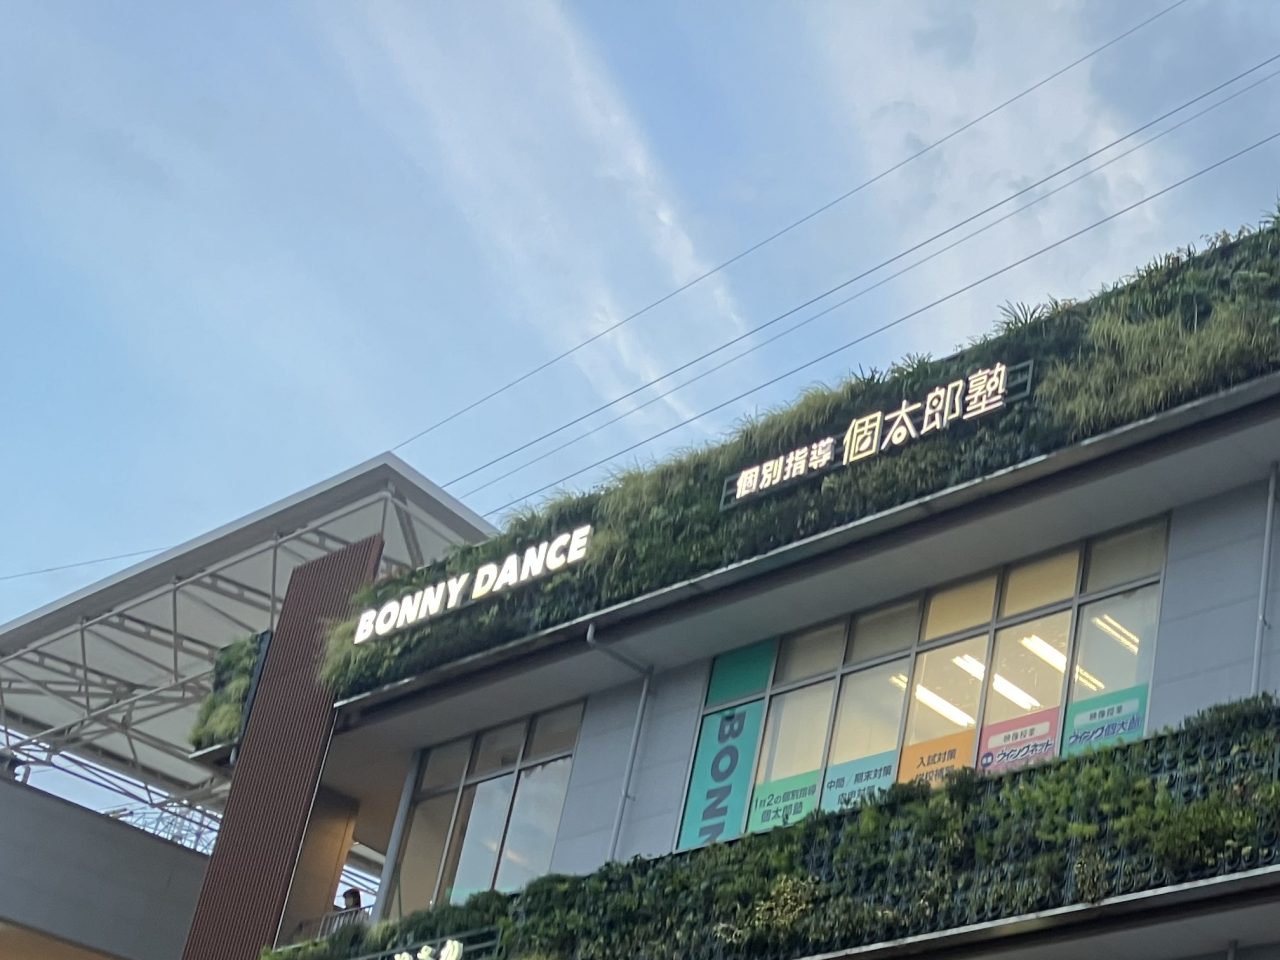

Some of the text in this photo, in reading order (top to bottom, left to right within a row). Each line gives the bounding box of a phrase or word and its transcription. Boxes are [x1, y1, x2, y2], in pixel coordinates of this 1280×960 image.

[736, 362, 1007, 499] 個別指導 個太郎塾
[354, 524, 594, 645] BONNY DANCE
